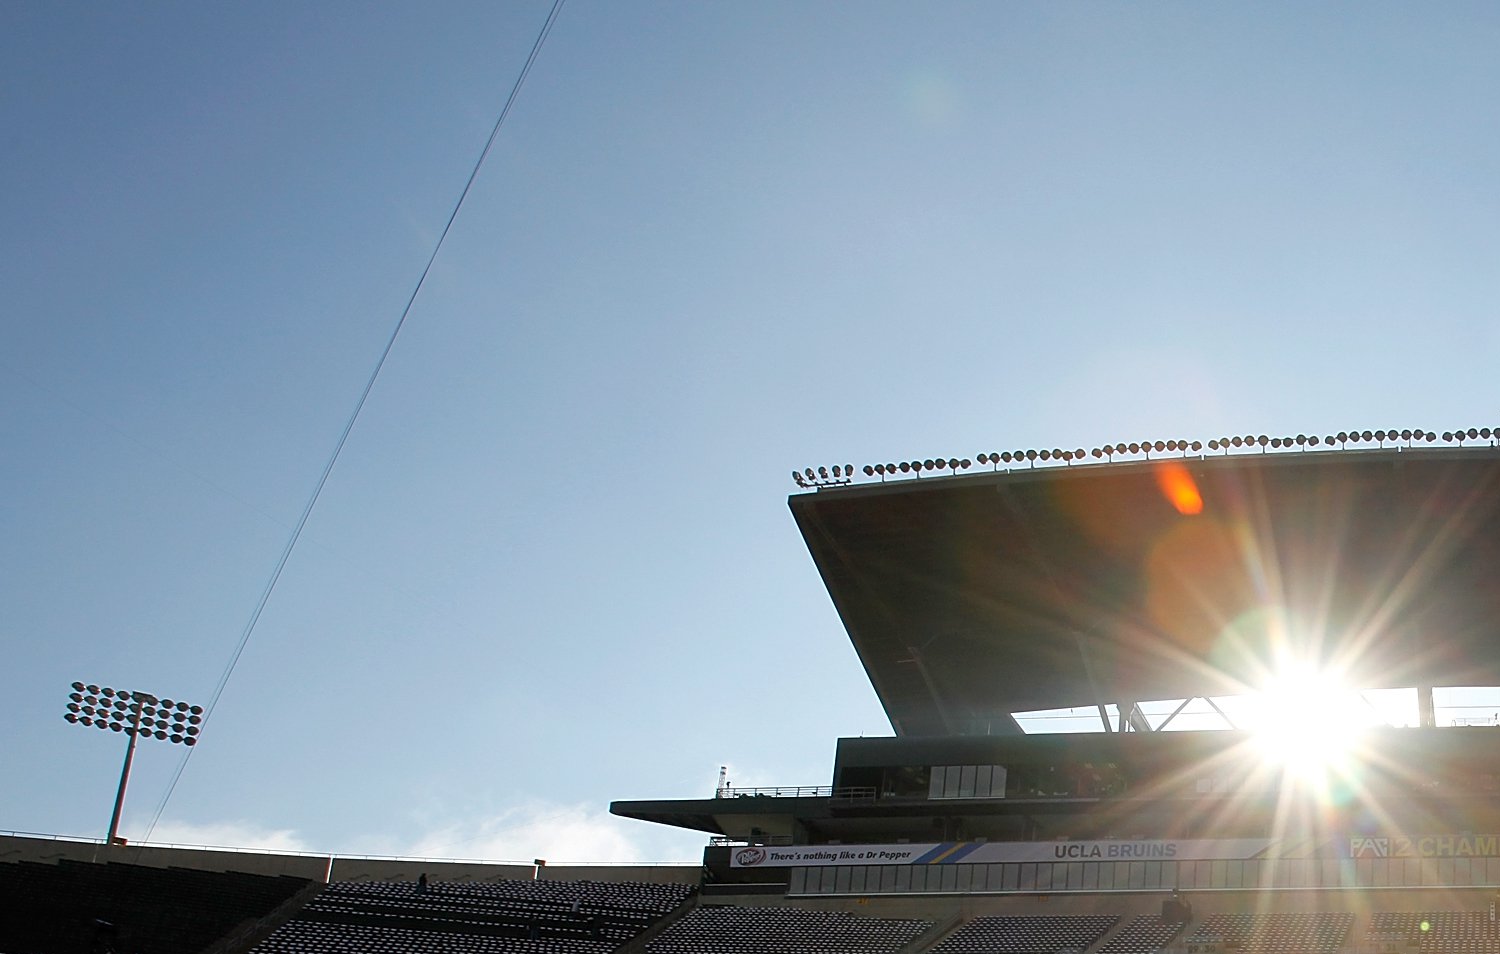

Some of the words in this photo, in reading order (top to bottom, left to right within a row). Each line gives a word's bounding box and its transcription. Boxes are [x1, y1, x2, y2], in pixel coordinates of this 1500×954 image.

[770, 852, 801, 861] There's
[803, 851, 838, 862] nothing
[839, 851, 856, 859] like
[866, 850, 877, 859] Dr
[879, 851, 911, 861] Pepper
[1055, 845, 1102, 858] UCLA
[1107, 844, 1177, 857] BRUINS
